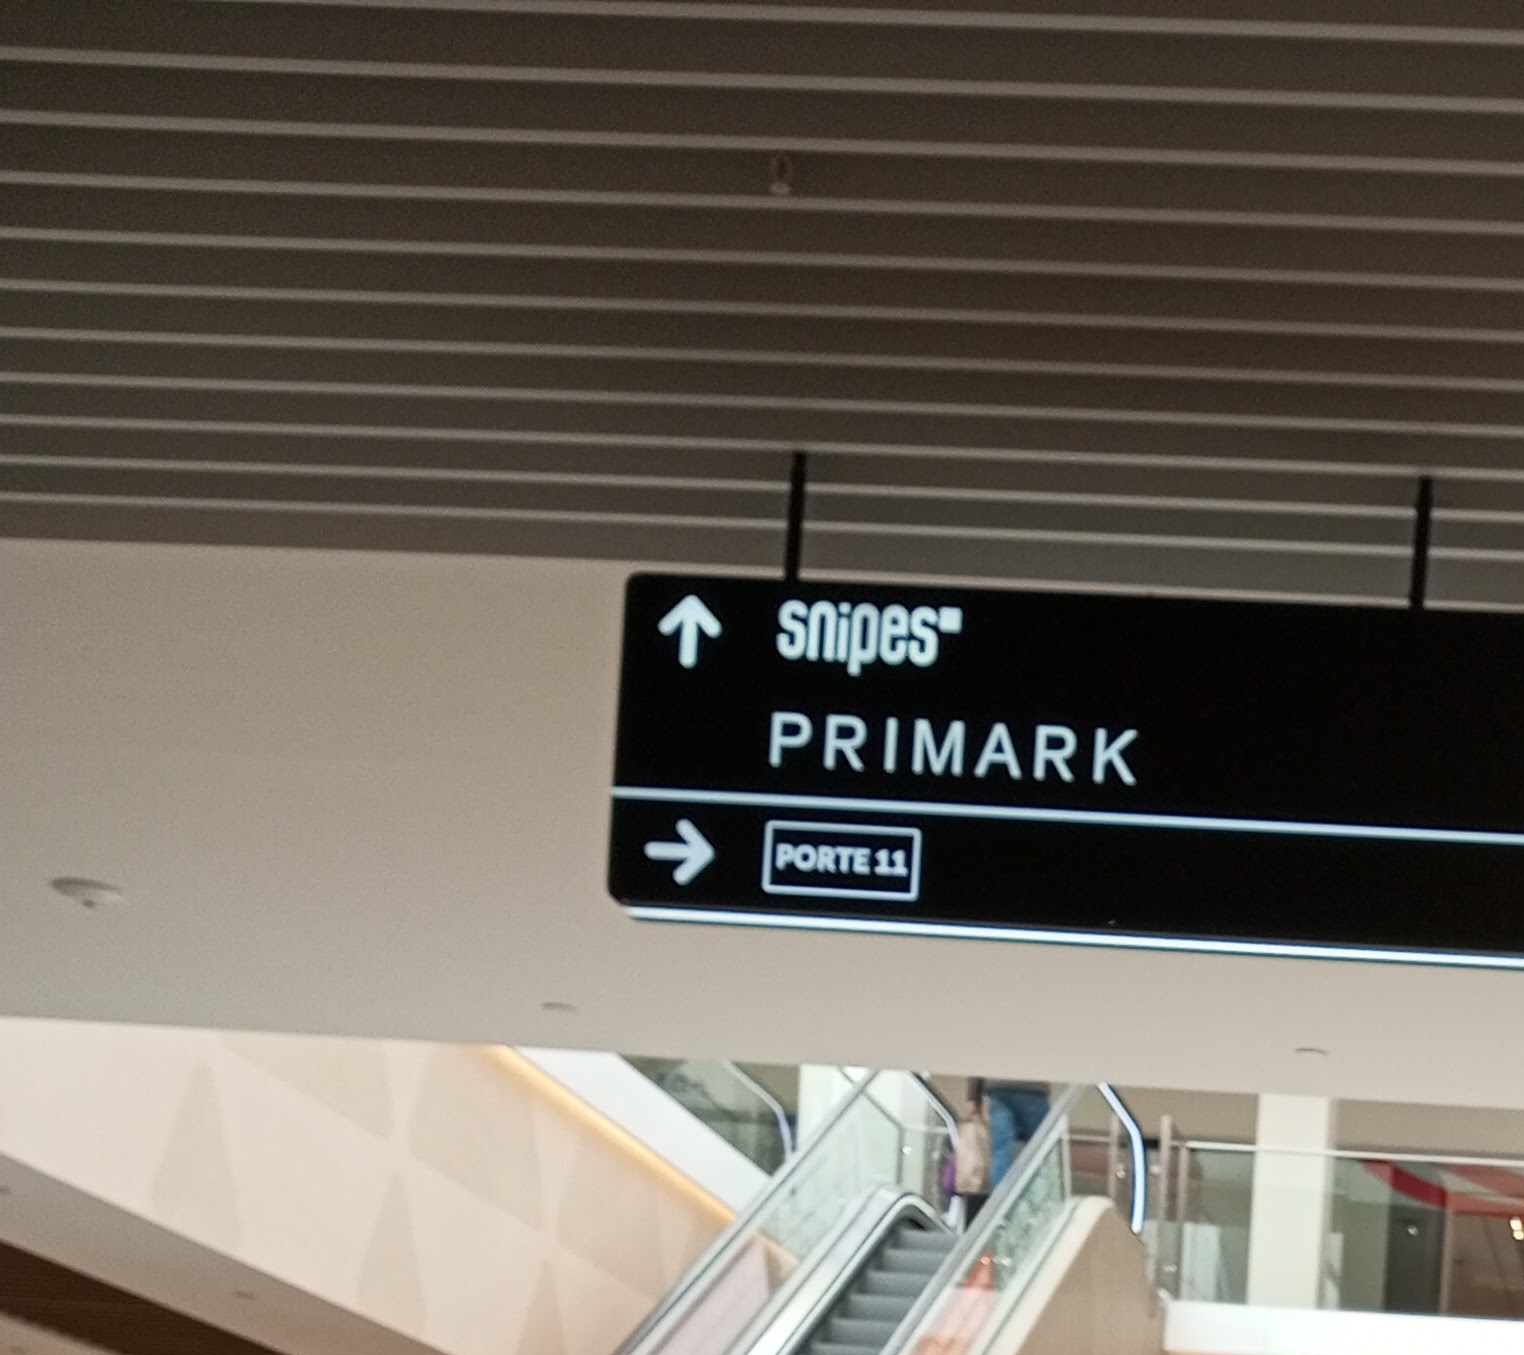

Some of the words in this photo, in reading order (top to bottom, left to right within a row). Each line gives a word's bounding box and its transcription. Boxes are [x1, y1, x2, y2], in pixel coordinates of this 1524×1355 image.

[768, 711, 1139, 787] PRIMARK
[775, 842, 871, 876] PORTE
[873, 847, 909, 878] 11
